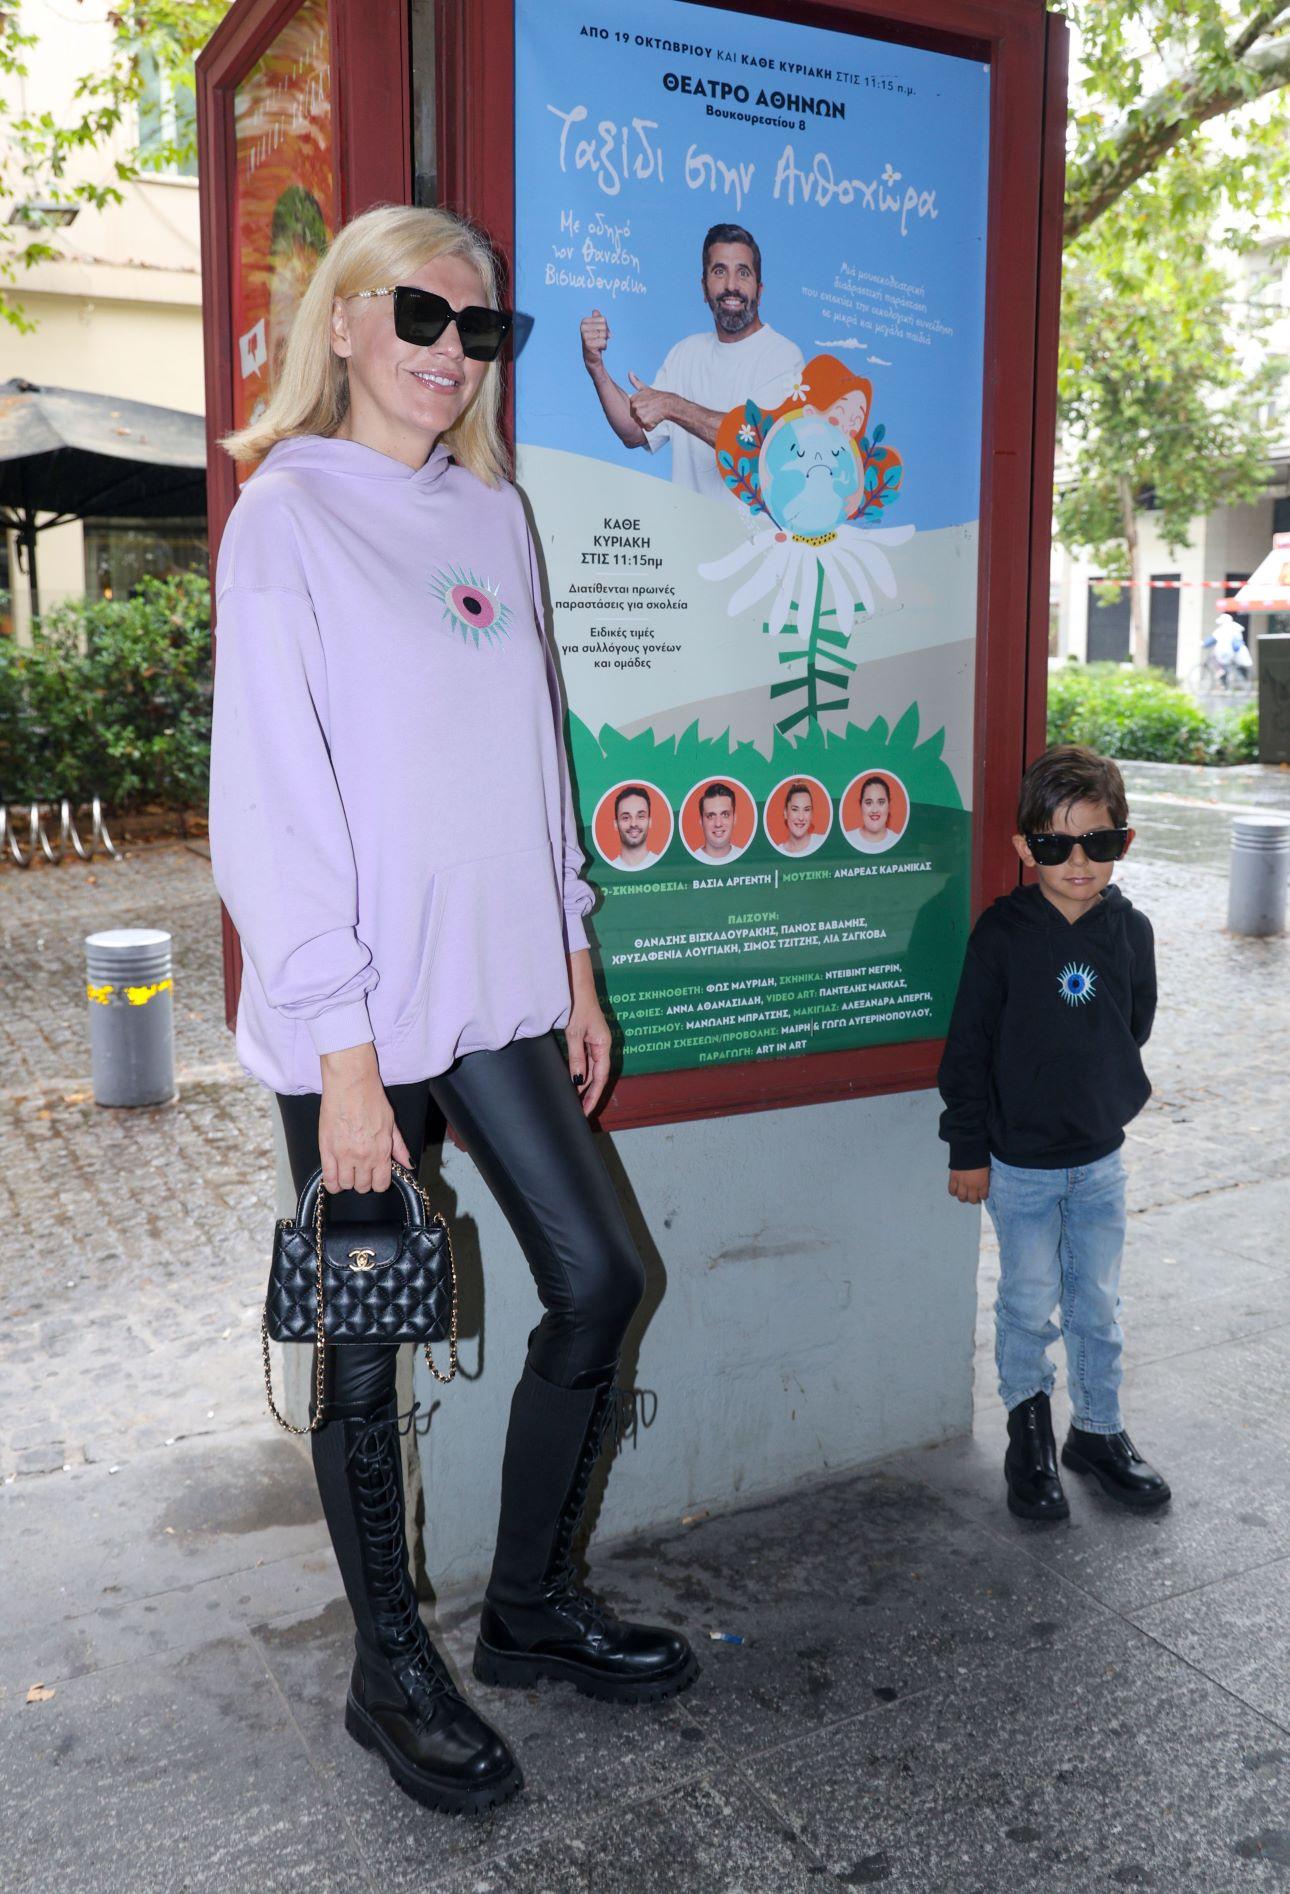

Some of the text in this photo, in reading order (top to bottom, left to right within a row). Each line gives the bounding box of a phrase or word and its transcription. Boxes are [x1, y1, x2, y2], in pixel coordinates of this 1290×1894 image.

[580, 25, 609, 39] ΑΠΟ
[615, 32, 629, 43] 19
[635, 35, 712, 58] ΟΚΤΩΒΡΙΟΥ
[717, 50, 736, 63] ΚΑΙ
[741, 54, 775, 70] ΚΑΘΕ
[779, 61, 832, 80] ΚΥΡΙΑΚΗ
[836, 71, 861, 85] ΣΤΙΣ
[865, 77, 894, 91] 11:15
[663, 72, 845, 120] ΘΕΑΤΡΟ ΑΘΗΝΩΝ
[706, 105, 806, 131] Βουκουρεστίου 8
[685, 143, 755, 212] στην
[560, 208, 631, 247] Με οδηγό
[552, 244, 574, 260] τον
[802, 286, 818, 298] που
[603, 518, 641, 531] ΚΑΘΕ
[593, 535, 651, 549] ΚΥΡΙΑΚΗ
[581, 552, 663, 569] ΣΤΙΣ 11:15πμ
[568, 583, 675, 596] Διατίθενται πρωινές
[555, 599, 688, 612] παραστάσεις για σχολεία
[590, 627, 655, 639] Ειδικές τιμές
[561, 642, 682, 655] για συλλόγους γονέων
[594, 657, 652, 670] και ομάδες
[693, 878, 724, 889] ΒΑΣΙΑ
[727, 874, 772, 887] ΑΡΓΕΝΤΗ
[782, 869, 832, 883] ΜΟΥΣΙΚΗ:
[833, 866, 878, 878] ΑΝΔΡΕΑΣ
[879, 862, 932, 874] ΚΑΡΑΝΙΚΑΣ
[727, 911, 779, 925] ΠΑΙΖΟΥΝ:
[634, 917, 868, 948] ΘΑΝΑΣΗΣ ΒΙΣΚΑΔΟΥΡΑΚΗΣ, ΠΑΝΟΣ ΒΑΒΑΜΗΣ,
[612, 929, 887, 965] ΧΡΥΣΑΦΕΝΙΑ ΛΟΥΓΙΑΚΗ, ΣΙΜΟΣ ΤΖΙΤΖΗΣ, ΛΙΑ ΖΑΓΚΟΒΑ
[638, 985, 704, 1000] ΣΚΗΝΟΘΕΤΗ:
[706, 982, 729, 993] ΦΩΣ
[731, 977, 777, 990] ΜΑΥΡΙΔΗ,
[779, 973, 823, 985] ΣΚΗΝΙΚΑ:
[825, 967, 867, 980] ΝΤΕΙΒΙΝΤ
[868, 963, 902, 975] ΝΕΓΡΙΝ,
[666, 1004, 694, 1016] ΑΝΝΑ
[697, 995, 764, 1011] ΑΘΑΝΑΣΙΑΔΗ,
[766, 992, 795, 1003] VIDEO
[796, 989, 818, 999] ART:
[819, 984, 867, 997] ΠΑΝΤΕΛΗΣ
[868, 979, 908, 991] ΜΑΚΚΑΣ,
[624, 1022, 684, 1037] ΦΩΤΙΣΜΟΥ:
[686, 1017, 736, 1030] ΜΑΝΩΛΗΣ
[737, 1009, 791, 1024] ΜΠΡΑΤΣΗΣ,
[841, 998, 895, 1011] ΑΛΕΞΑΝΔΡΑ
[897, 992, 933, 1004] ΑΠΕΡΓΗ,
[622, 1040, 671, 1055] ΗΜΟΣΙΩΝ
[781, 1023, 810, 1035] ΜΑΙΡΗ
[813, 1021, 819, 1031] &
[821, 1018, 847, 1029] ΓΩΓΩ
[848, 1008, 932, 1026] ΑΥΓΕΡΙΝΟΠΟΥΛΟΥ,
[699, 1040, 807, 1062] ΠΑΡΑΓΩΓΗ: ART IN ART
